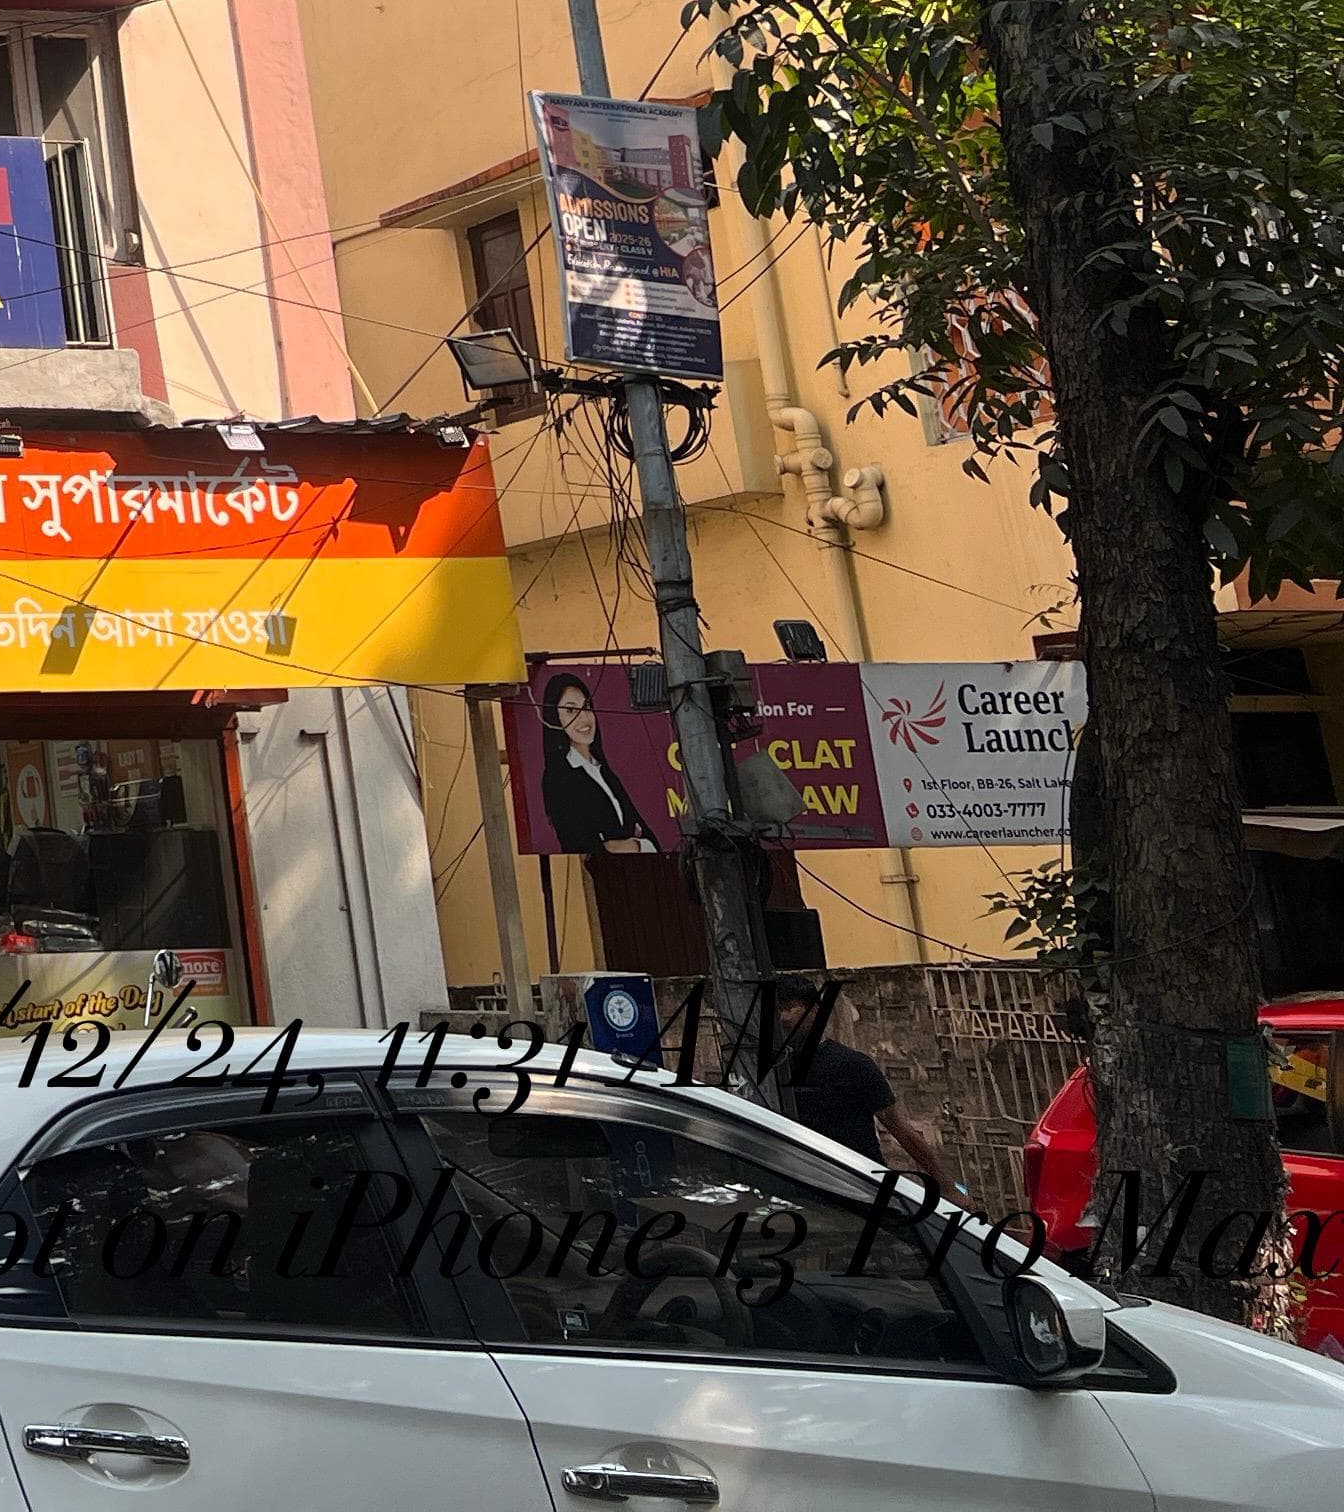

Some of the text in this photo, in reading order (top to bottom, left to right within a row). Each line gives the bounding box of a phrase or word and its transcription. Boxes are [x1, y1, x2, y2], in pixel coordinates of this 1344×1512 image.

[590, 101, 647, 115] INTERNATIONAL
[649, 108, 683, 118] ACADEMY
[559, 193, 650, 224] ADMISSIONS
[562, 213, 607, 241] OPEN
[609, 232, 652, 247] 2025-26
[22, 456, 299, 541] সুপারমার্কেট
[89, 607, 175, 648] আসা
[183, 606, 287, 647] যাওয়া
[787, 702, 813, 716] For
[957, 684, 1064, 715] Career
[768, 740, 856, 770] CLAT
[921, 779, 937, 790] 1st
[941, 778, 975, 791] Floor,
[977, 778, 1016, 791] BB-26,
[1018, 778, 1041, 789] Salt
[802, 785, 859, 816] AW
[926, 802, 1046, 819] 033-4003-7777
[931, 827, 1072, 840] www.careerlauncher.co
[15, 998, 62, 1024] start
[64, 992, 88, 1018] of
[88, 990, 118, 1017] the
[119, 984, 164, 1017] Day
[950, 1012, 1078, 1041] MAHARA
